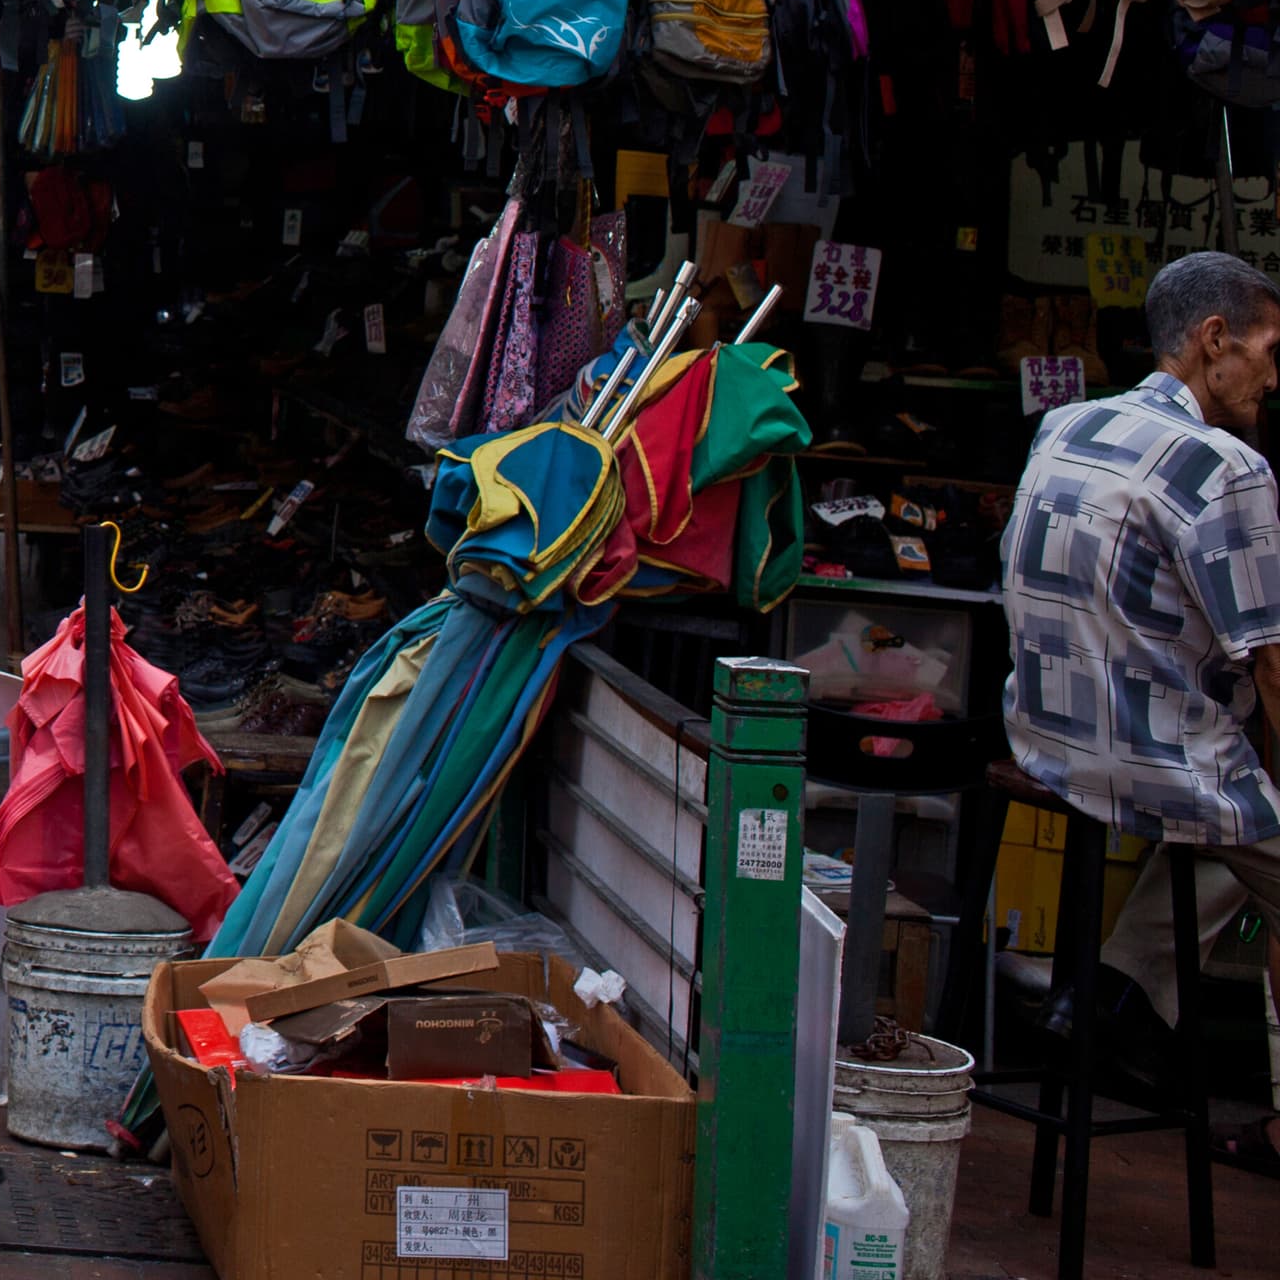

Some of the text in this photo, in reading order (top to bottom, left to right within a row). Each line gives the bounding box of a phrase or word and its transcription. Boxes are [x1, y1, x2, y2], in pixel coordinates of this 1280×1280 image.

[739, 858, 783, 869] 24772000
[553, 1204, 581, 1222] KGS
[510, 1253, 526, 1271] 42
[528, 1254, 544, 1271] 43
[546, 1255, 562, 1273] 44
[565, 1255, 581, 1274] 45
